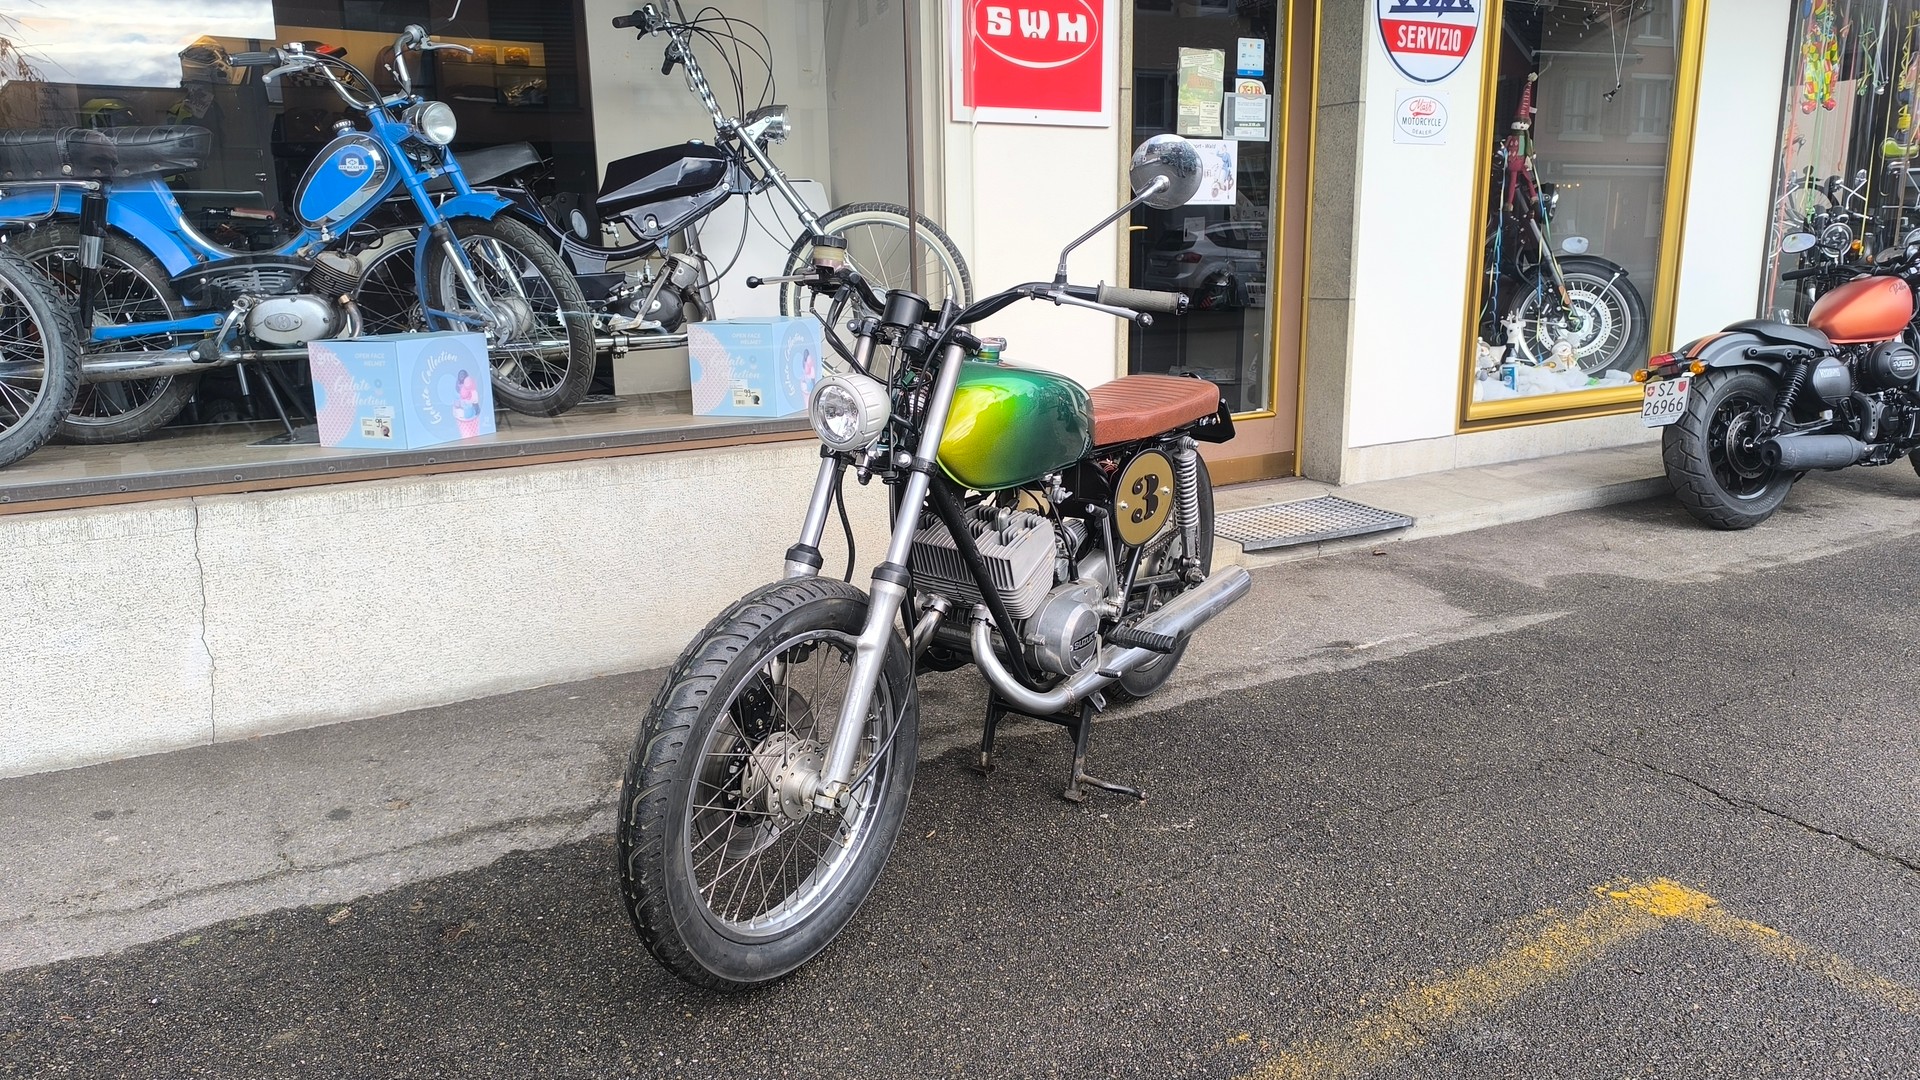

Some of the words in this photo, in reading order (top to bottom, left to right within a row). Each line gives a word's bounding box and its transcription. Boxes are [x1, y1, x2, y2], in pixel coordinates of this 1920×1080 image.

[986, 6, 1088, 43] SWM
[1397, 24, 1462, 52] SERVIZIO
[1401, 116, 1441, 127] MOTORCYCLE
[422, 351, 458, 385] Collection
[335, 376, 370, 394] Gelato
[1658, 381, 1675, 397] SZ
[421, 388, 442, 425] Gelato
[1644, 396, 1684, 416] 26966
[1131, 473, 1160, 524] 3
